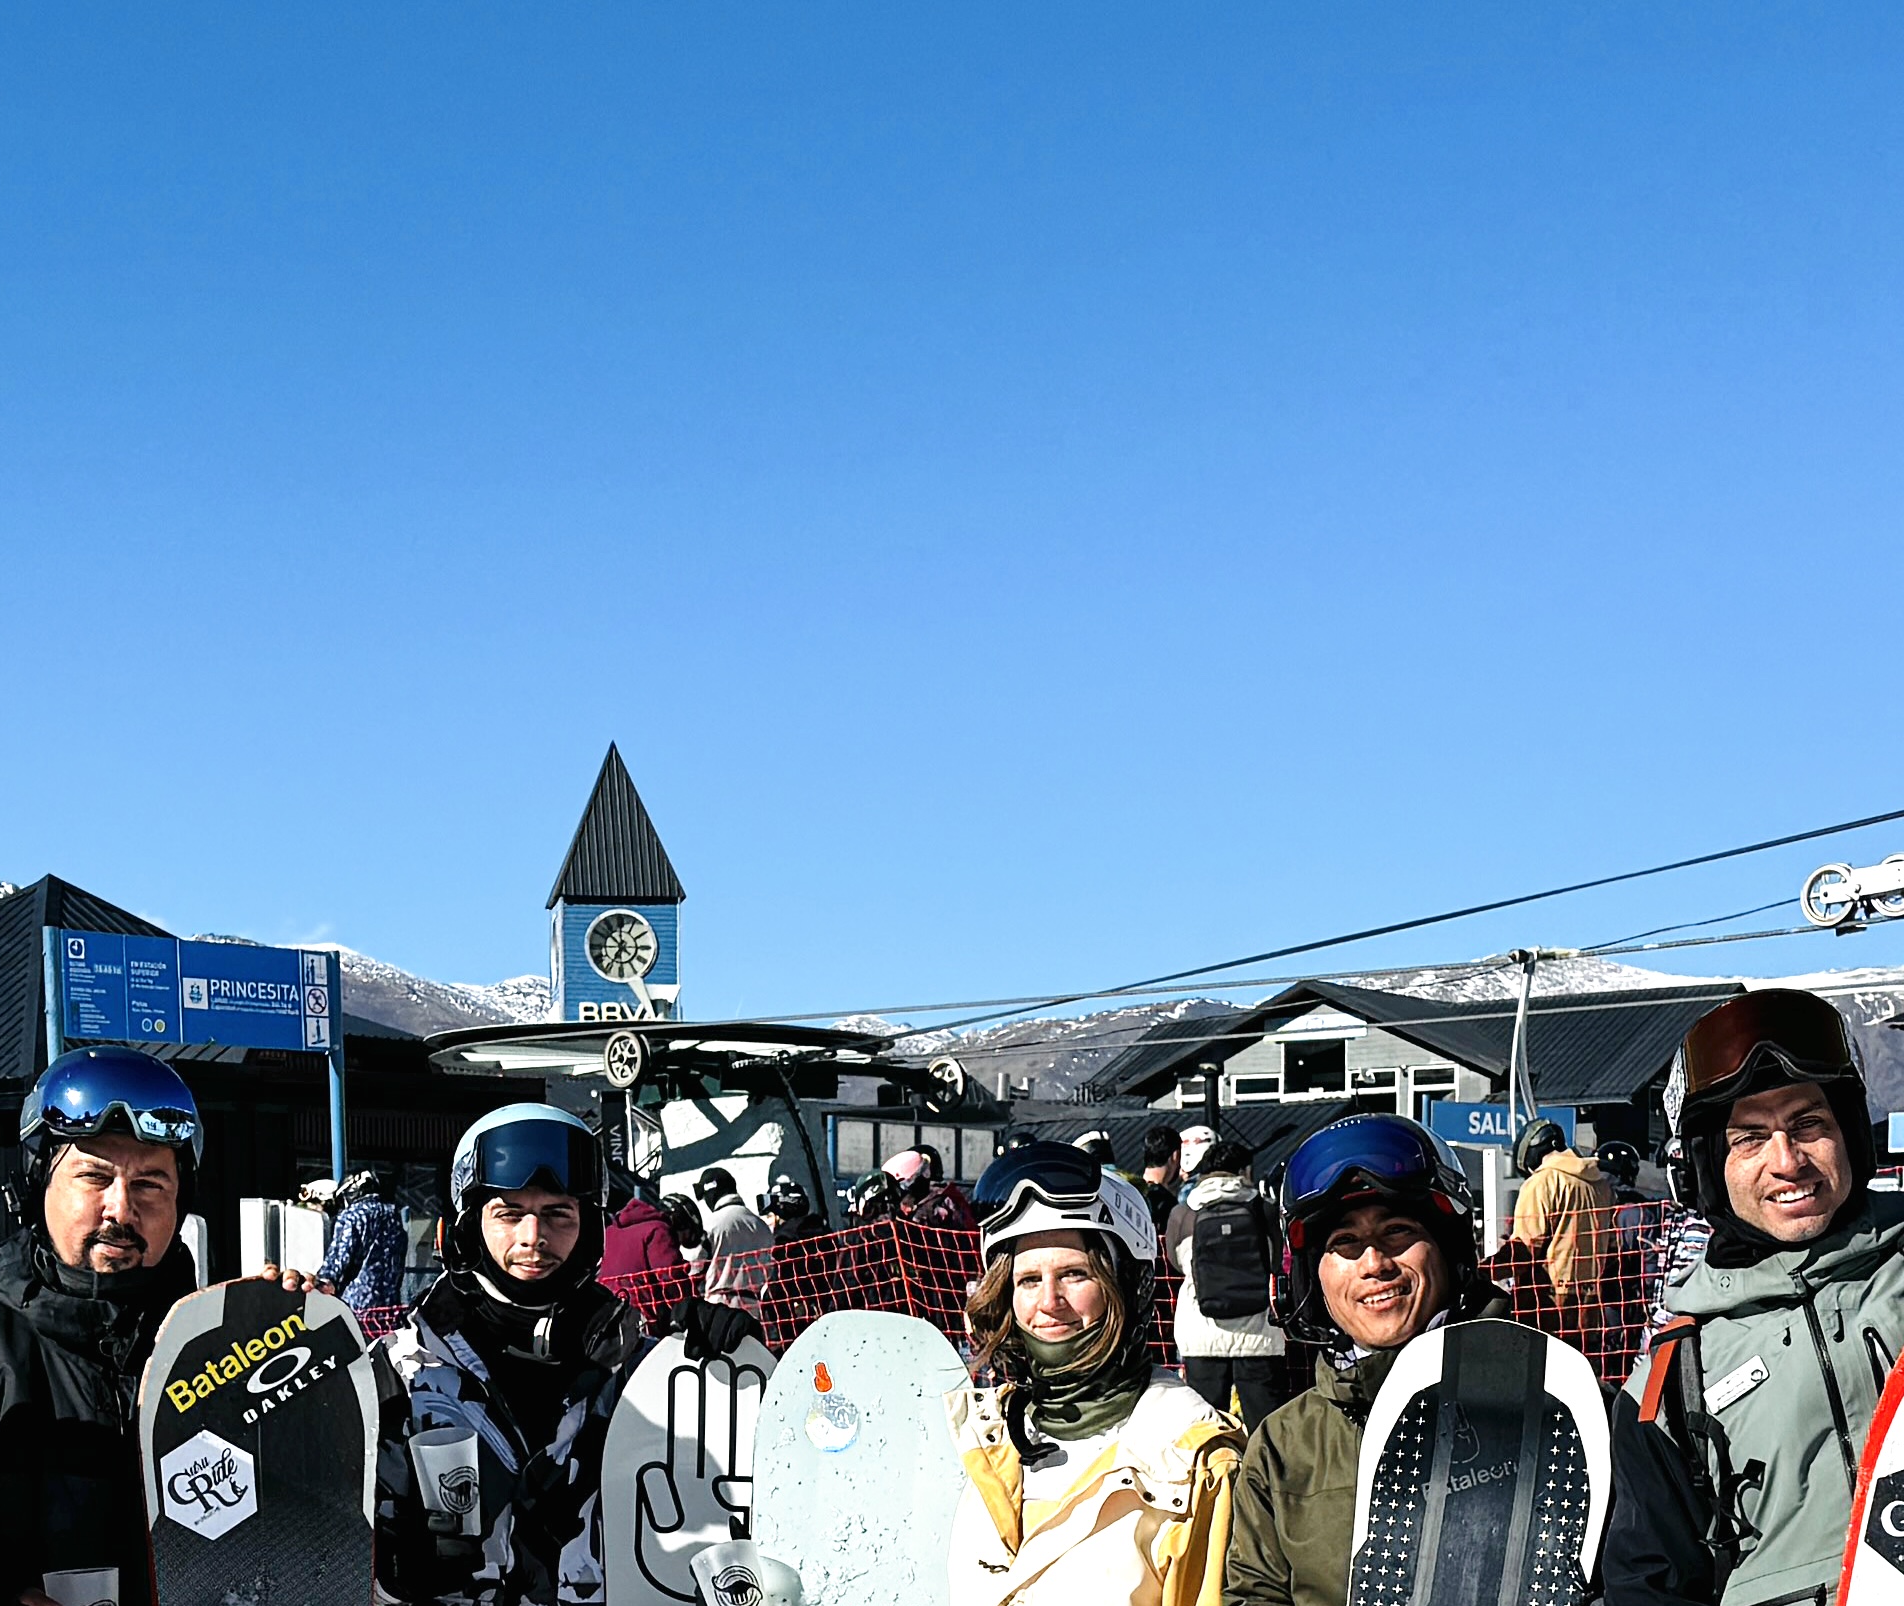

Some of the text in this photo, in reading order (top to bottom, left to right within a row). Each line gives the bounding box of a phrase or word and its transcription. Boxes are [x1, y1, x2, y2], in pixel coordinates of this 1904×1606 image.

[210, 979, 300, 1002] PRINCESITA
[165, 1313, 307, 1414] Bataleon
[242, 1355, 338, 1425] OAKLEY
